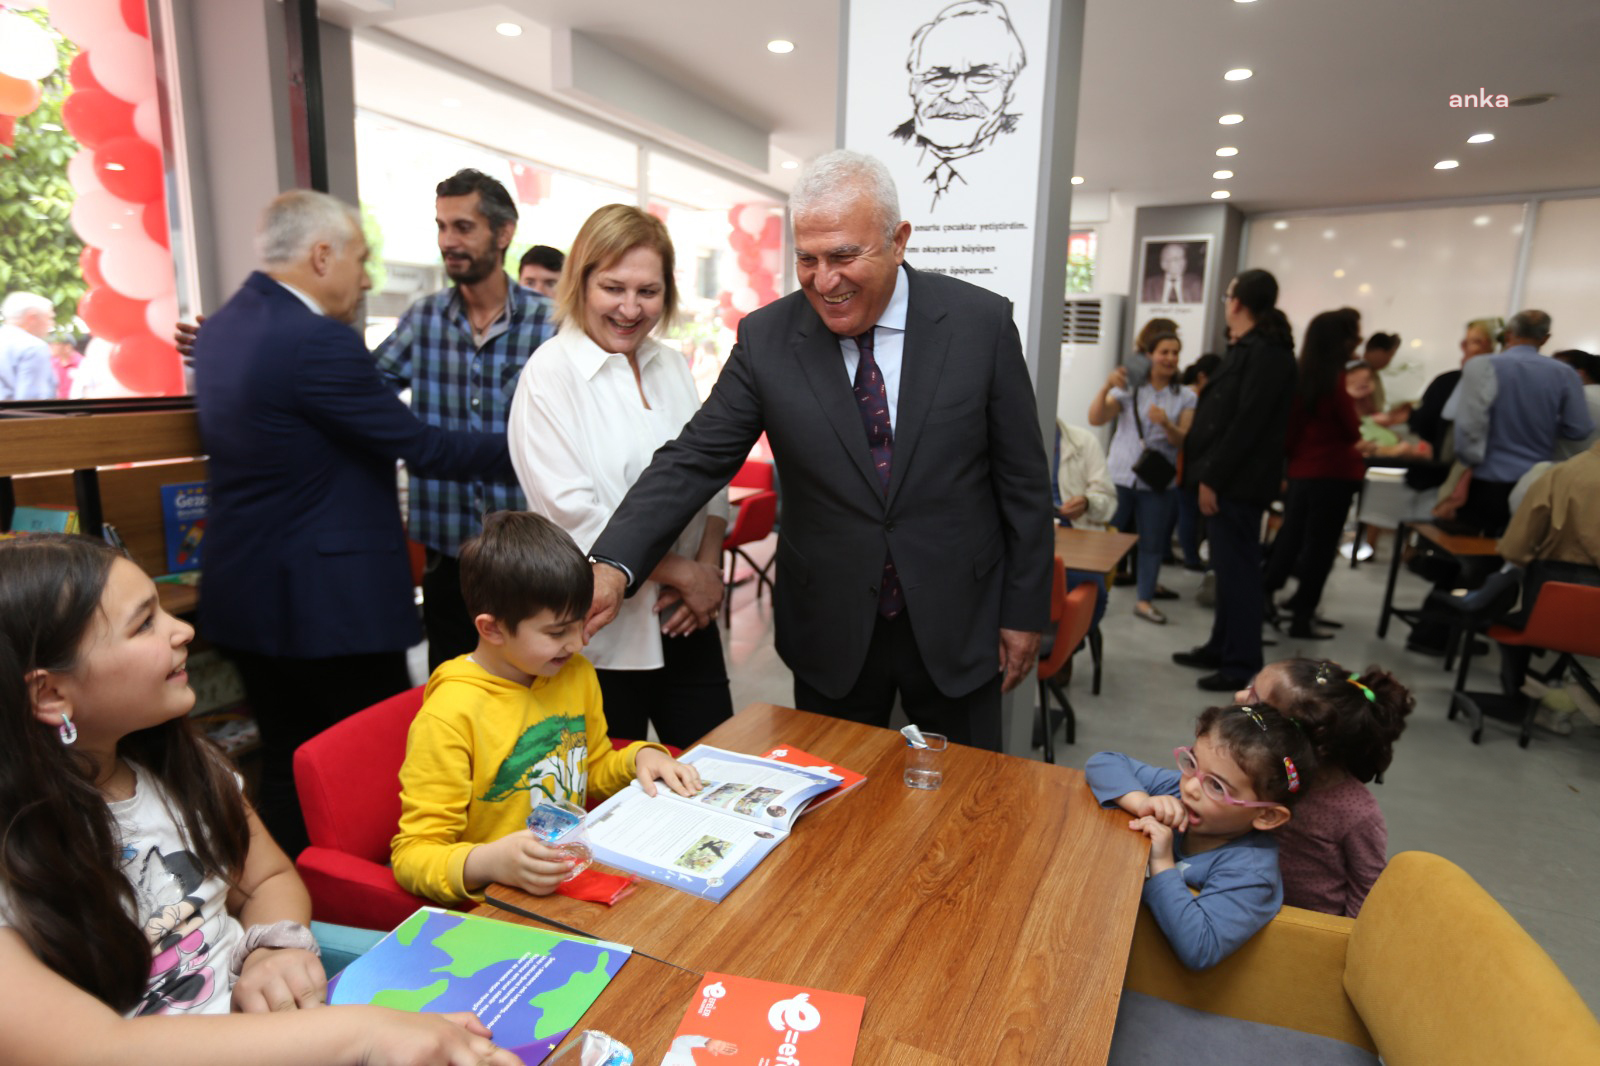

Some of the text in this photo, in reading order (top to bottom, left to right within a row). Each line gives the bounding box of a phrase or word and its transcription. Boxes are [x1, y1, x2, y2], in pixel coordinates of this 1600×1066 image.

[943, 223, 976, 233] çocuklar
[922, 245, 958, 255] okuyarak
[961, 244, 996, 255] büyüyen
